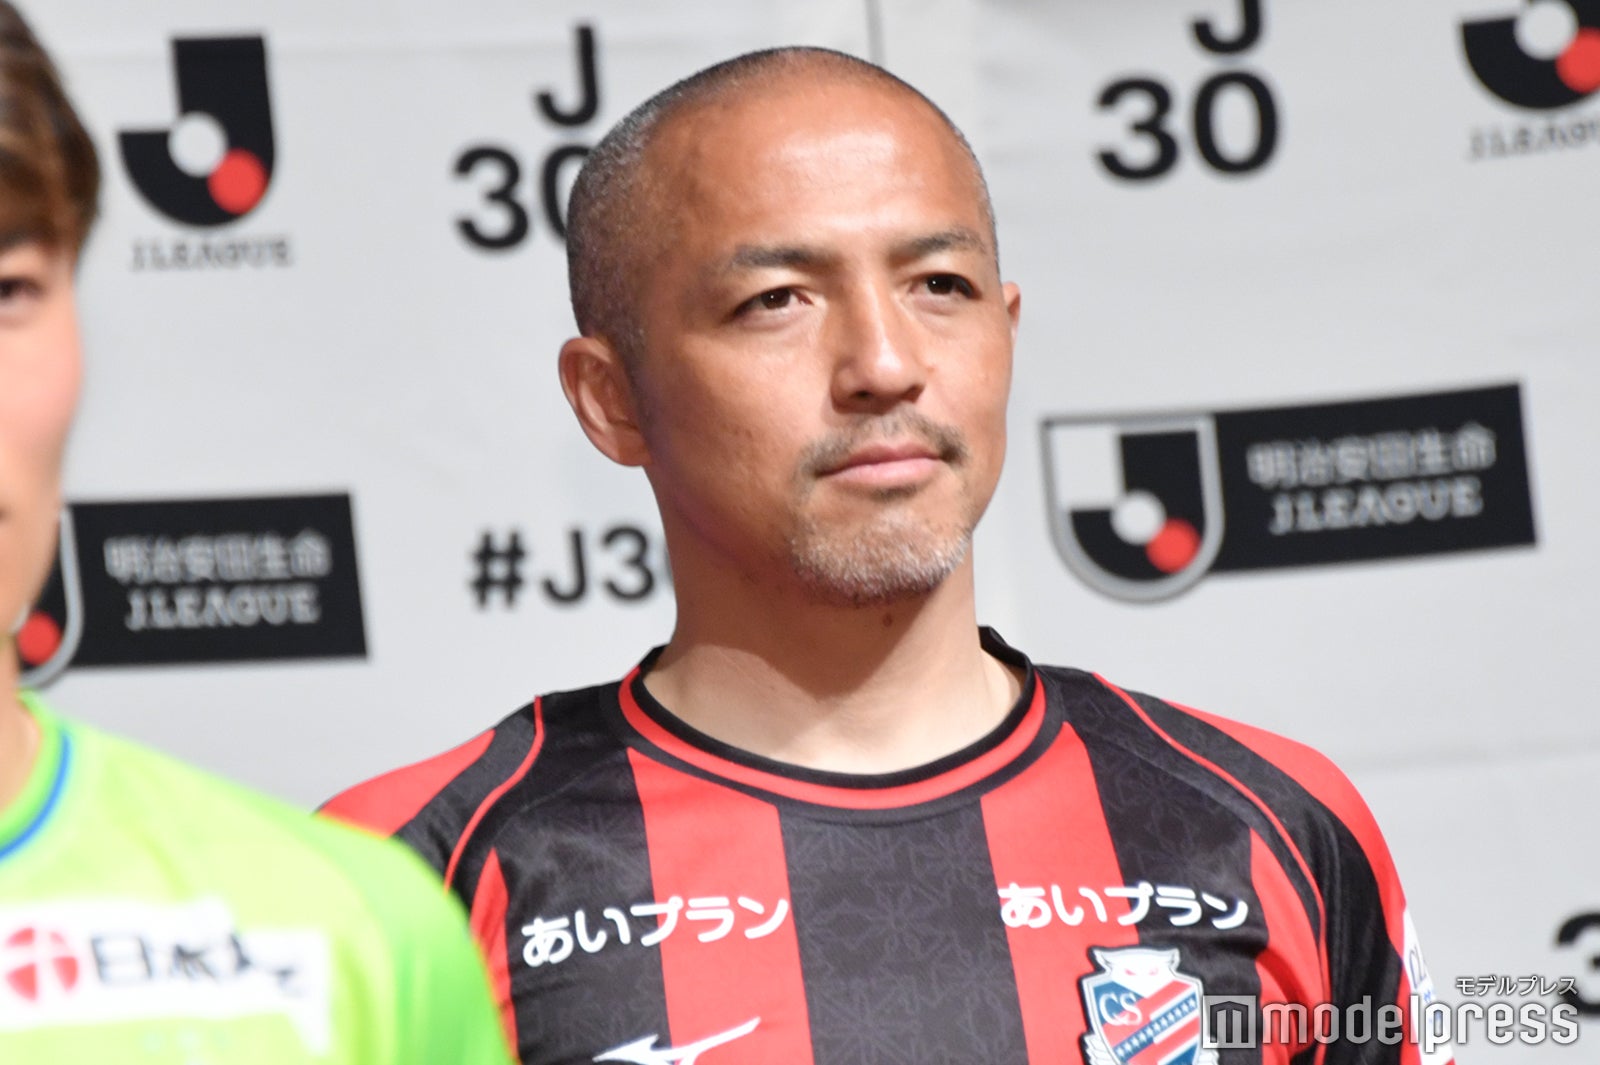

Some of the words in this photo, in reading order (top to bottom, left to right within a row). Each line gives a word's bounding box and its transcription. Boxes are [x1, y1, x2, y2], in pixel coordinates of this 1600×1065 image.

[1192, 0, 1263, 54] J
[534, 26, 599, 127] J
[1097, 70, 1280, 181] 30
[1246, 421, 1497, 489] 明治安田生命
[470, 524, 673, 608] #J3
[521, 895, 789, 968] あいプラン
[997, 880, 1249, 930] あいプラン
